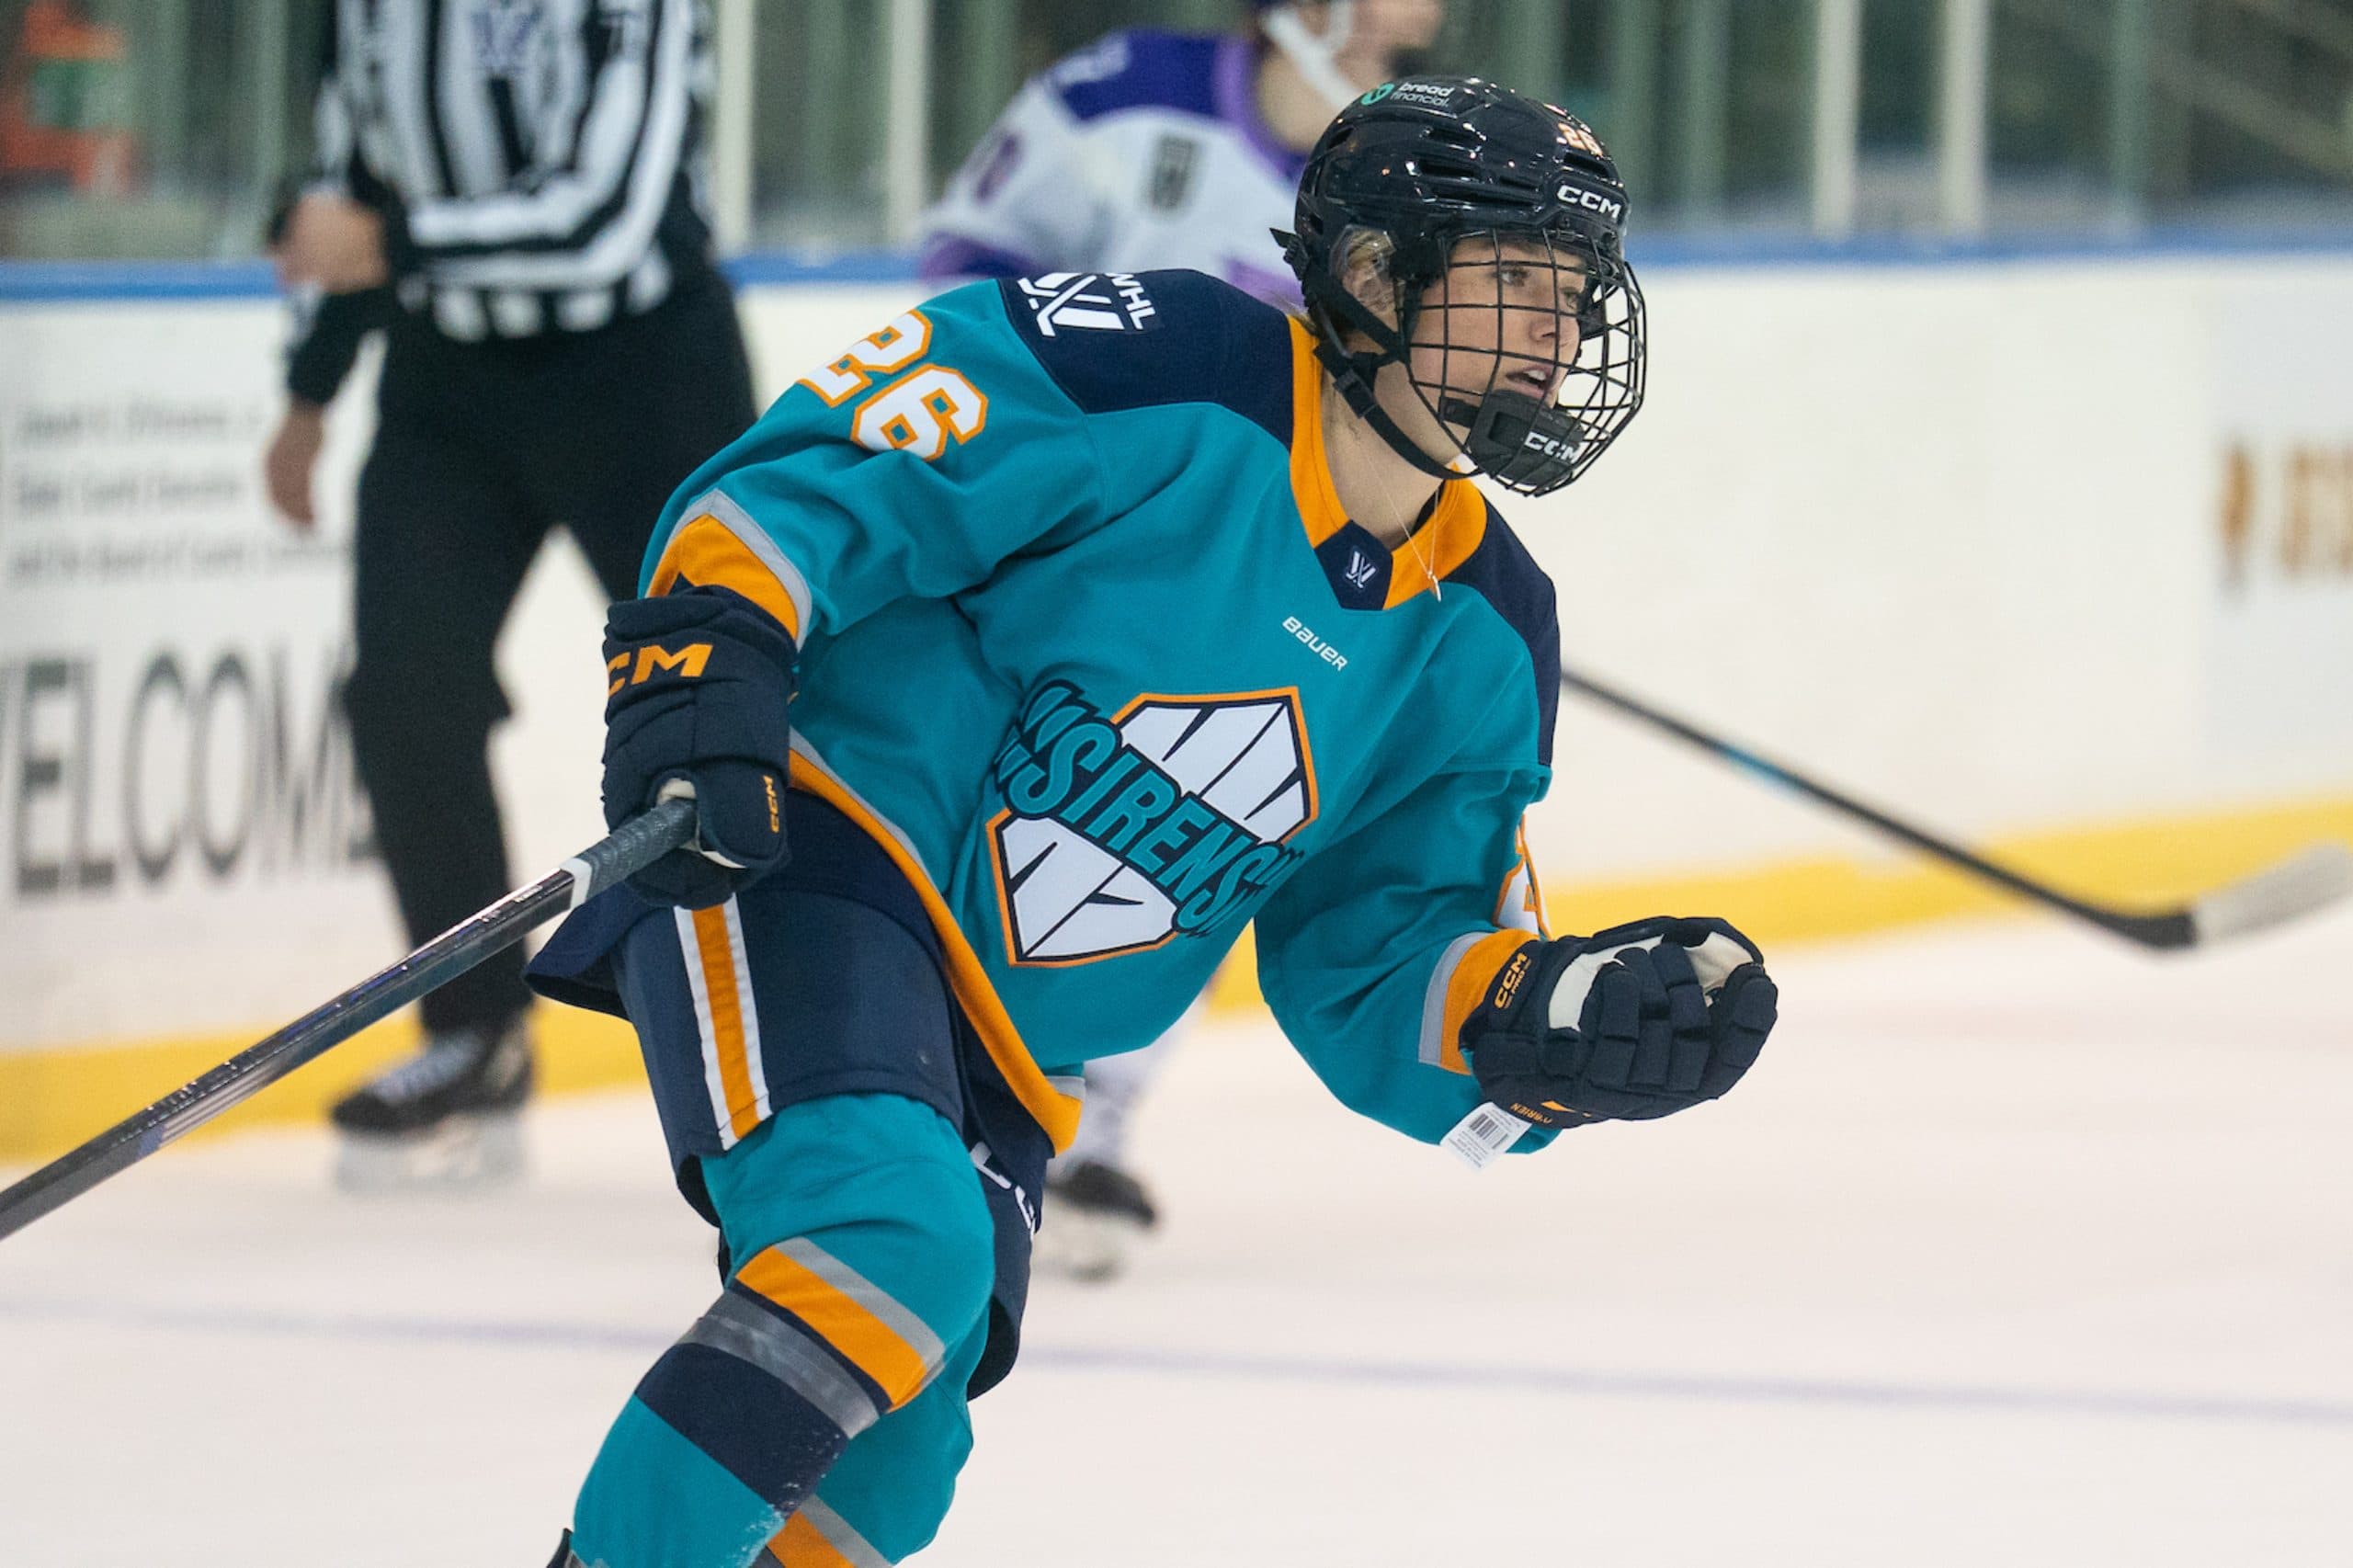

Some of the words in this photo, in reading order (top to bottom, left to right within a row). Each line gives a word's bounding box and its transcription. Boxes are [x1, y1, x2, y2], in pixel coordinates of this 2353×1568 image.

[1398, 83, 1455, 97] bread
[1557, 185, 1621, 219] CCM
[797, 308, 989, 462] 26
[1524, 431, 1586, 465] CCM
[0, 646, 379, 893] ELCOM
[762, 775, 780, 834] CCM
[1008, 721, 1284, 932] SIRENS
[1495, 952, 1528, 1009] CCM
